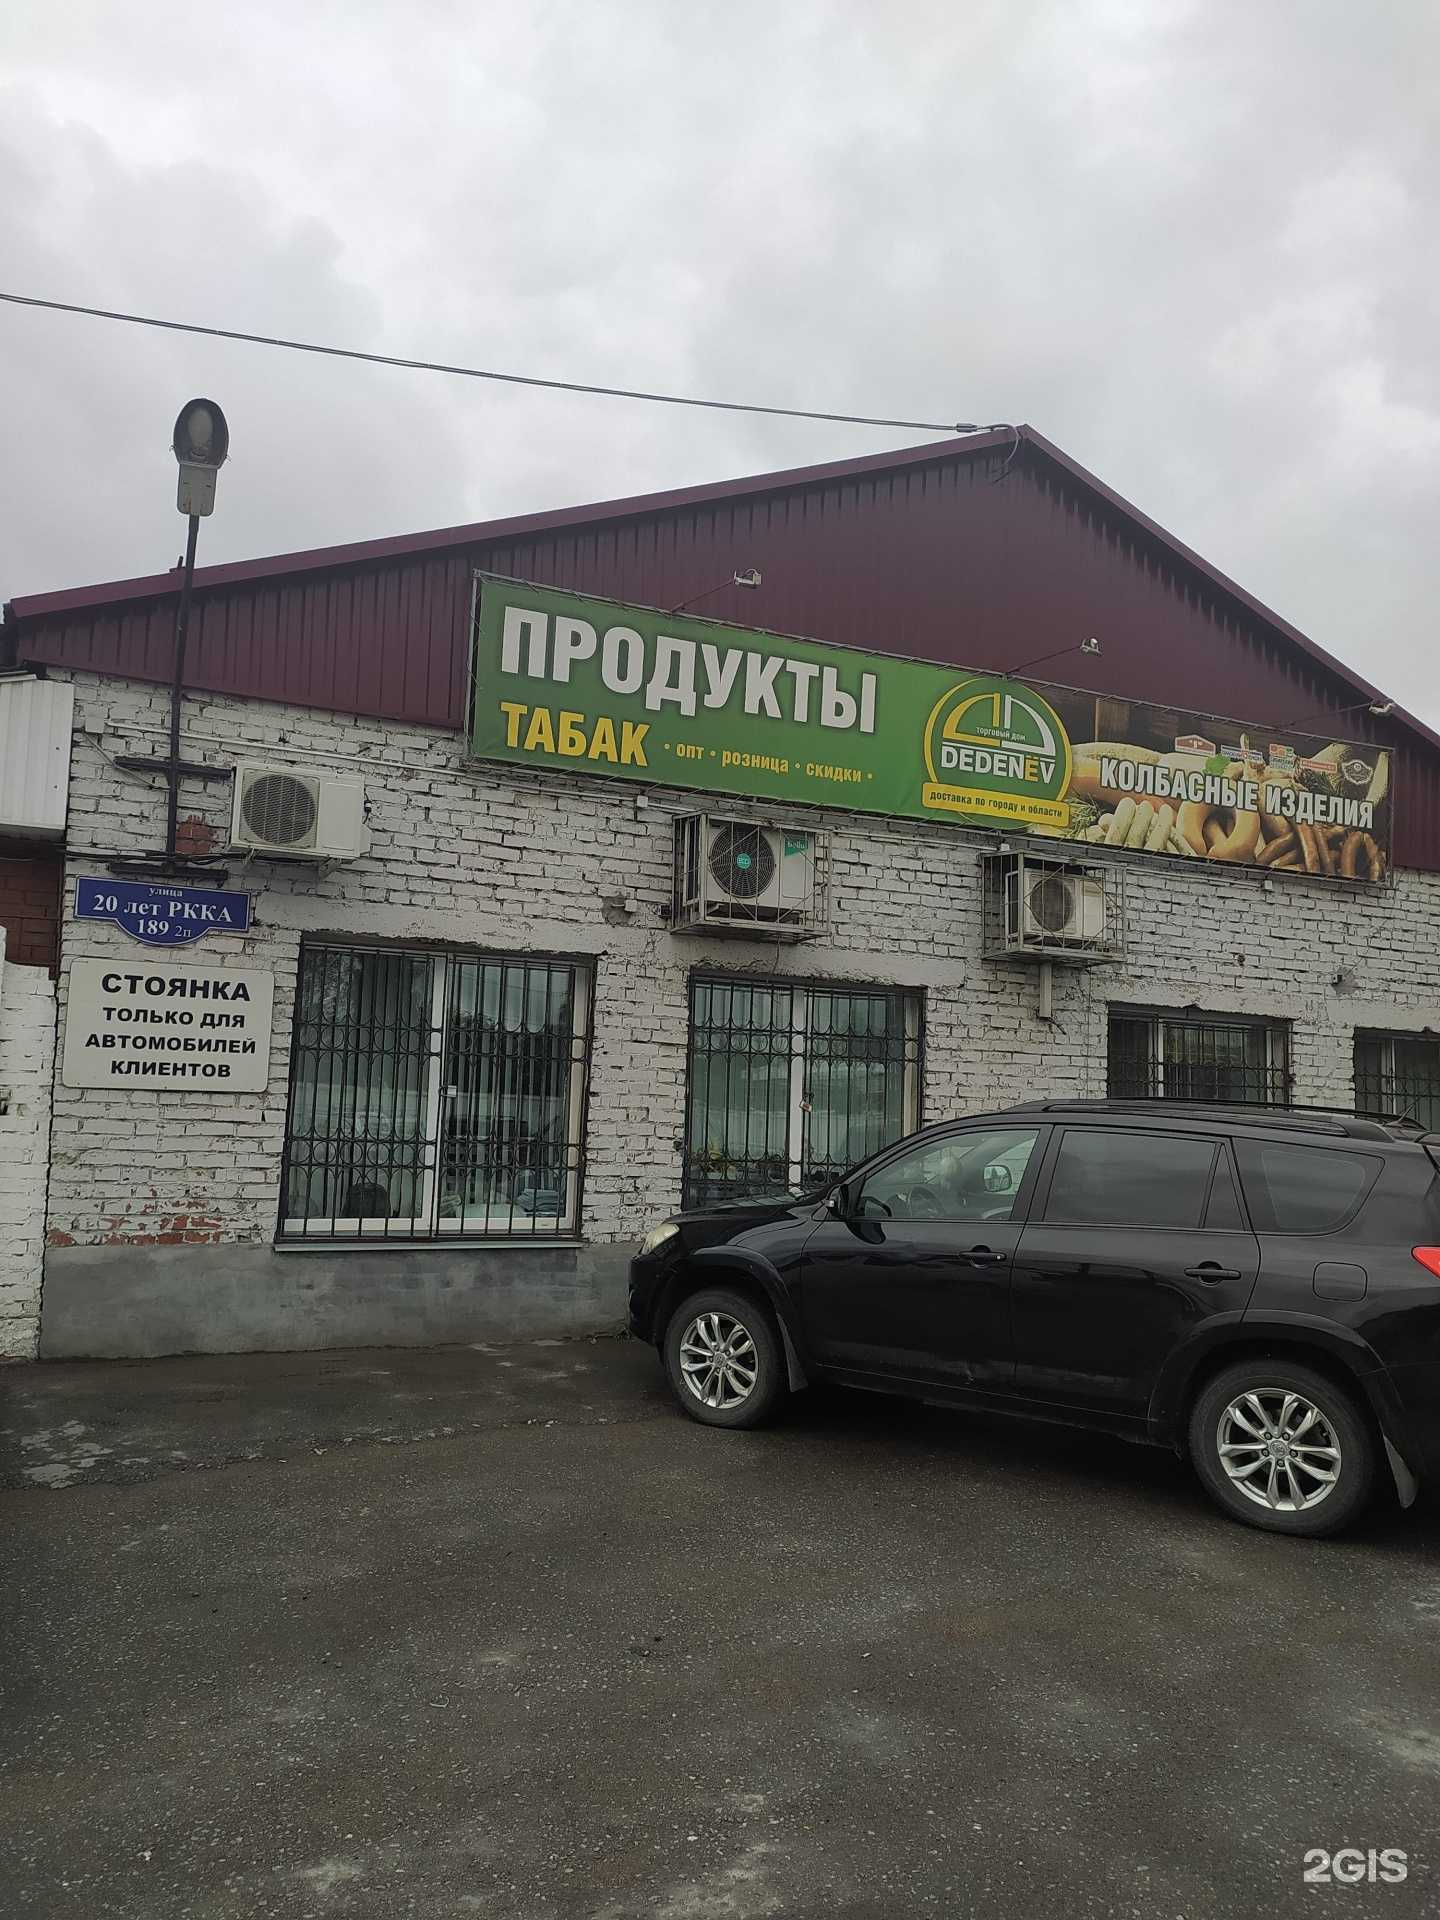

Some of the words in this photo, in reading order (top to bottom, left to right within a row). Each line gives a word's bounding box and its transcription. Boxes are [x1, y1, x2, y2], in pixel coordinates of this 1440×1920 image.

[501, 606, 877, 733] ПРОДУКТЫ
[500, 701, 650, 767] ТАБАК
[976, 727, 1010, 739] торговый
[1011, 732, 1026, 741] дом
[676, 743, 705, 760] опт
[722, 750, 789, 773] розница
[806, 762, 862, 783] скидки
[929, 792, 972, 805] доставка
[975, 797, 986, 806] по
[988, 799, 1018, 812] городу
[1020, 804, 1026, 812] и
[1028, 805, 1063, 817] области
[1100, 757, 1259, 811] КОЛБАСНЫЕ
[1265, 785, 1374, 829] ИЗДЕЛИЯ
[149, 887, 183, 897] улица
[93, 894, 118, 912] 20
[123, 902, 162, 916] лет
[167, 901, 233, 922] РККА
[137, 919, 169, 935] 189
[101, 973, 251, 1001] СТОЯНКА
[103, 1007, 194, 1025] ТОЛЬКО
[199, 1013, 246, 1029] ДЛЯ
[85, 1033, 256, 1054] АВТОМОБИЛЕЙ
[111, 1060, 231, 1078] КЛИЕНТОВ
